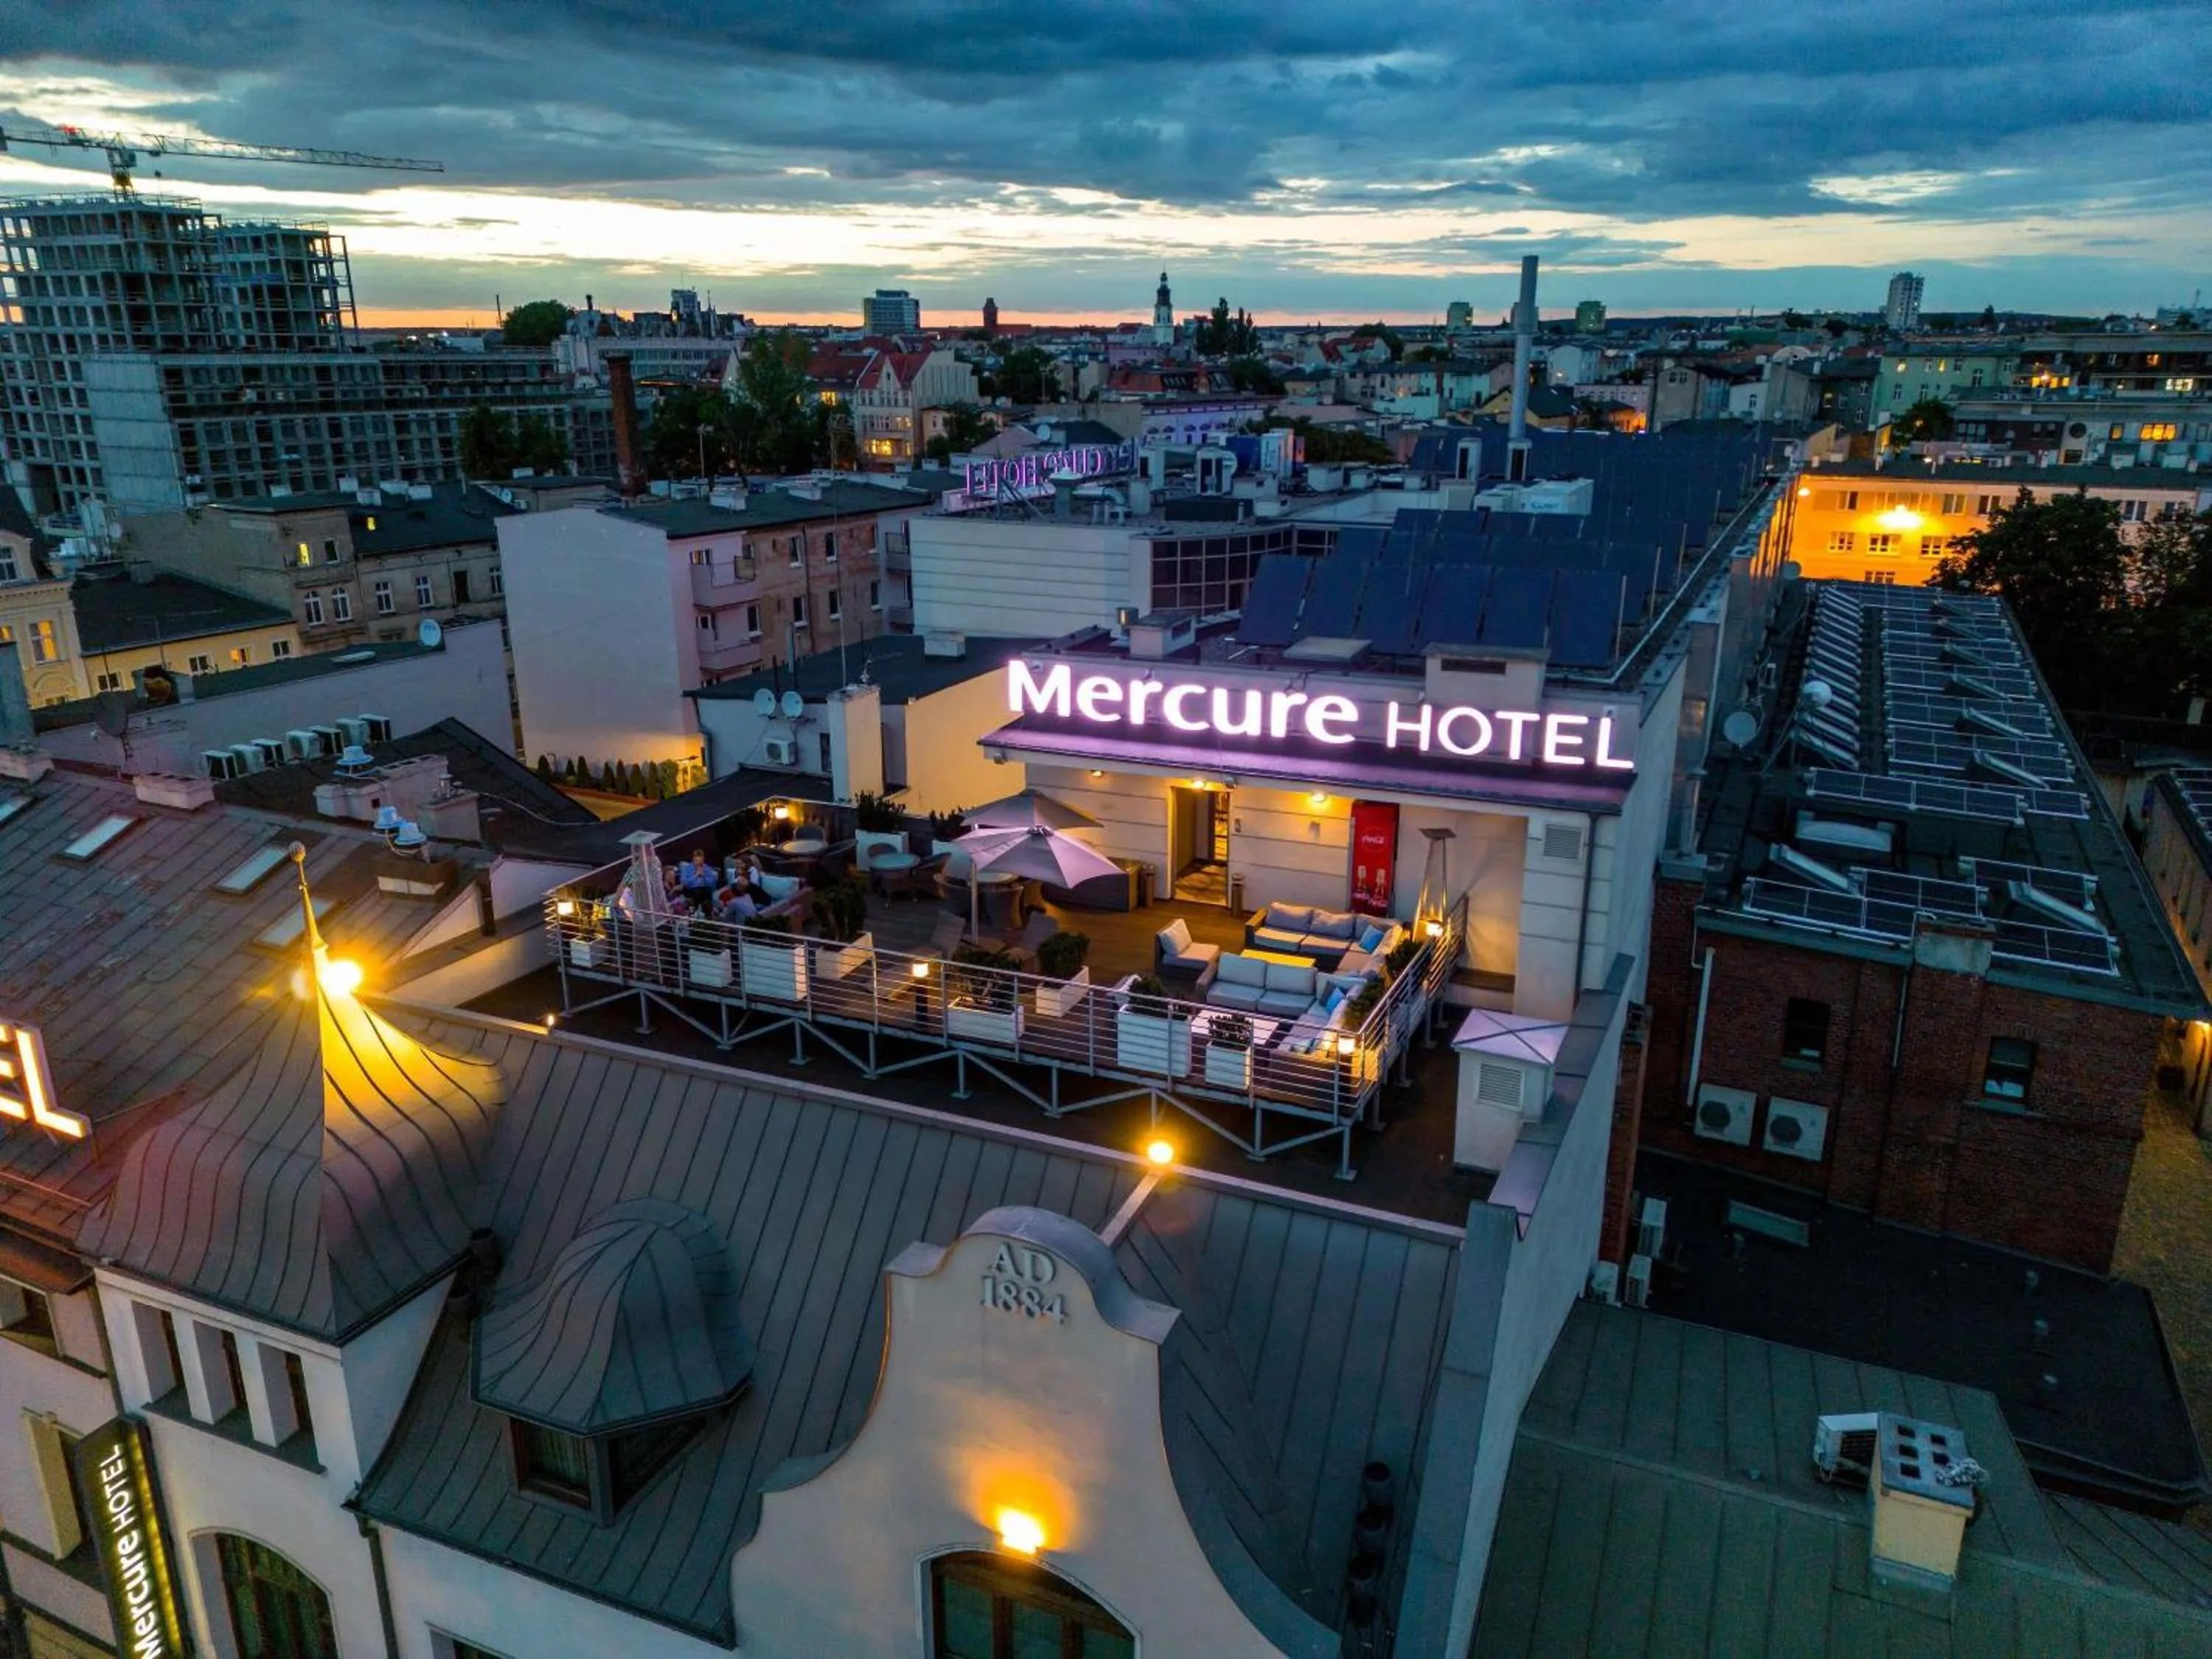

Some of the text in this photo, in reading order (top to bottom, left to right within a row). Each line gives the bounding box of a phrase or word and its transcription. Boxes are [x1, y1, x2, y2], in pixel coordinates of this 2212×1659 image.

[1008, 660, 1635, 769] Mercure HOTEL
[981, 1275, 1070, 1325] 1884
[987, 1242, 1057, 1284] AD
[99, 1444, 162, 1659] Mercure HOTEL
